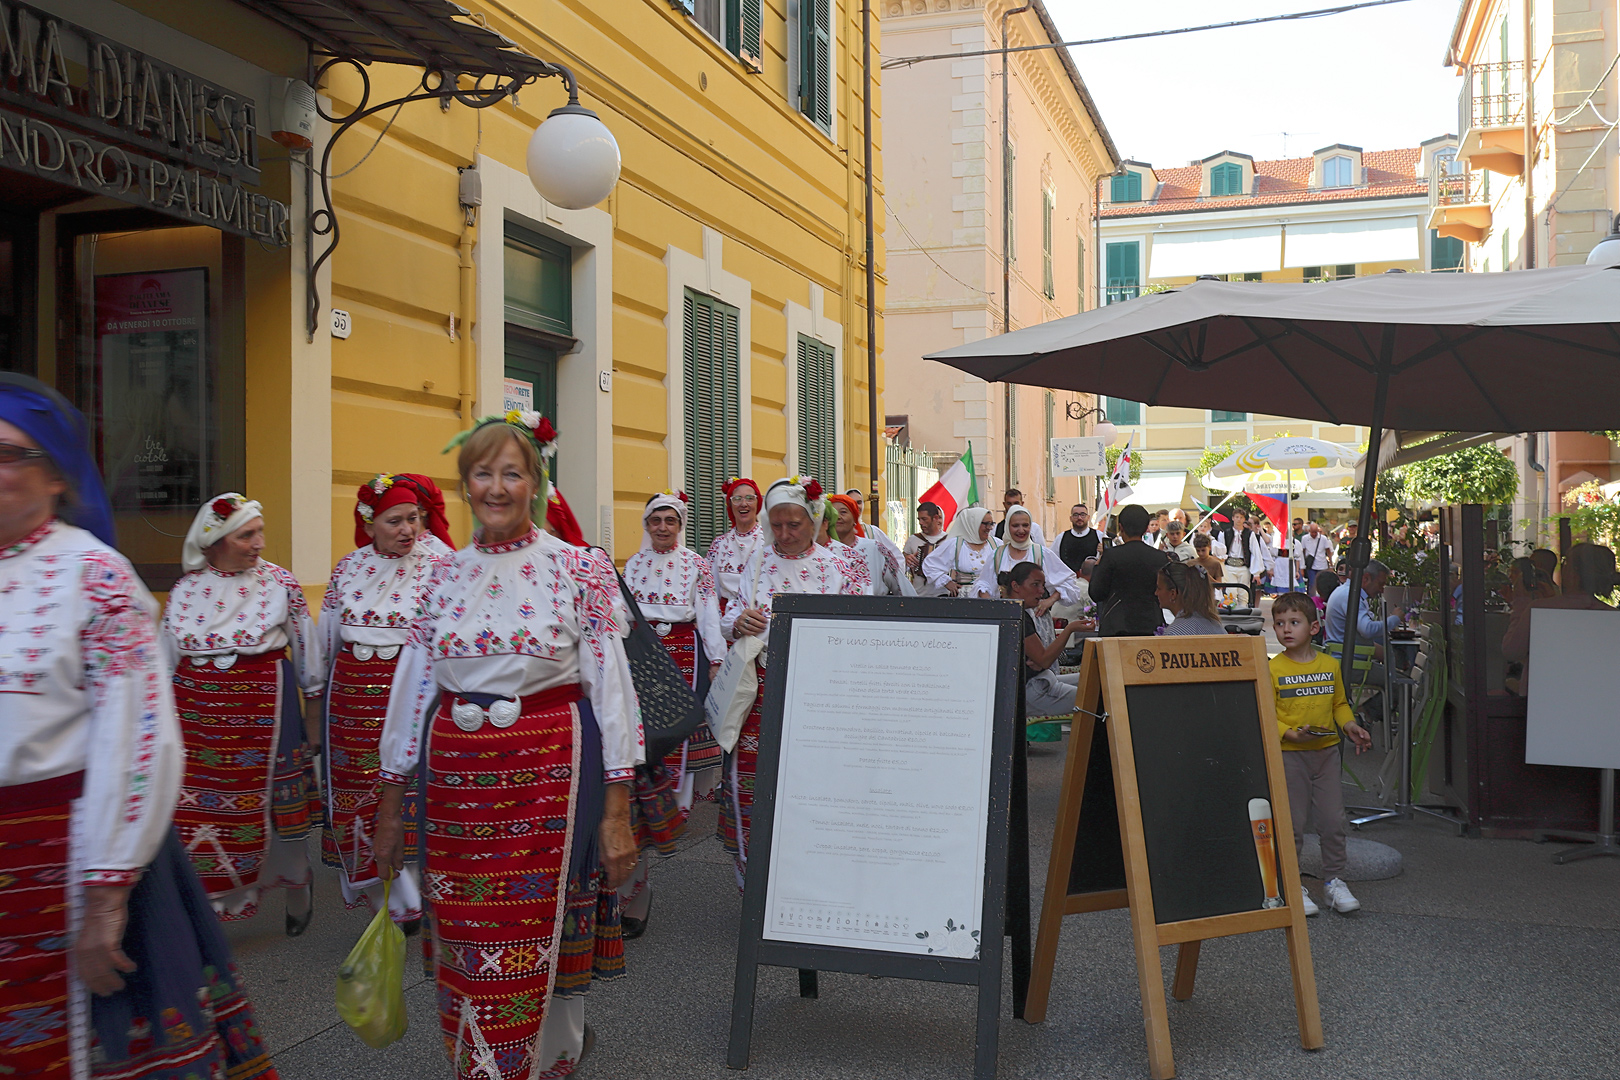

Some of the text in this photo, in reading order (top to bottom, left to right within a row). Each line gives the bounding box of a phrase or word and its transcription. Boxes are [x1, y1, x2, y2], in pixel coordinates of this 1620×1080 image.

[97, 41, 262, 173] DIANESE
[149, 159, 295, 247] PALMIERI
[107, 317, 197, 331] DA VENERDÌ 10 OTTOBRE
[144, 434, 163, 450] tre
[133, 448, 169, 463] ciotole
[828, 635, 845, 646] Per
[847, 638, 868, 647] uno
[870, 637, 920, 651] spuntino
[1161, 649, 1242, 669] PAULANER
[1285, 672, 1333, 684] RUNAWAY
[1295, 685, 1334, 696] CULTURE
